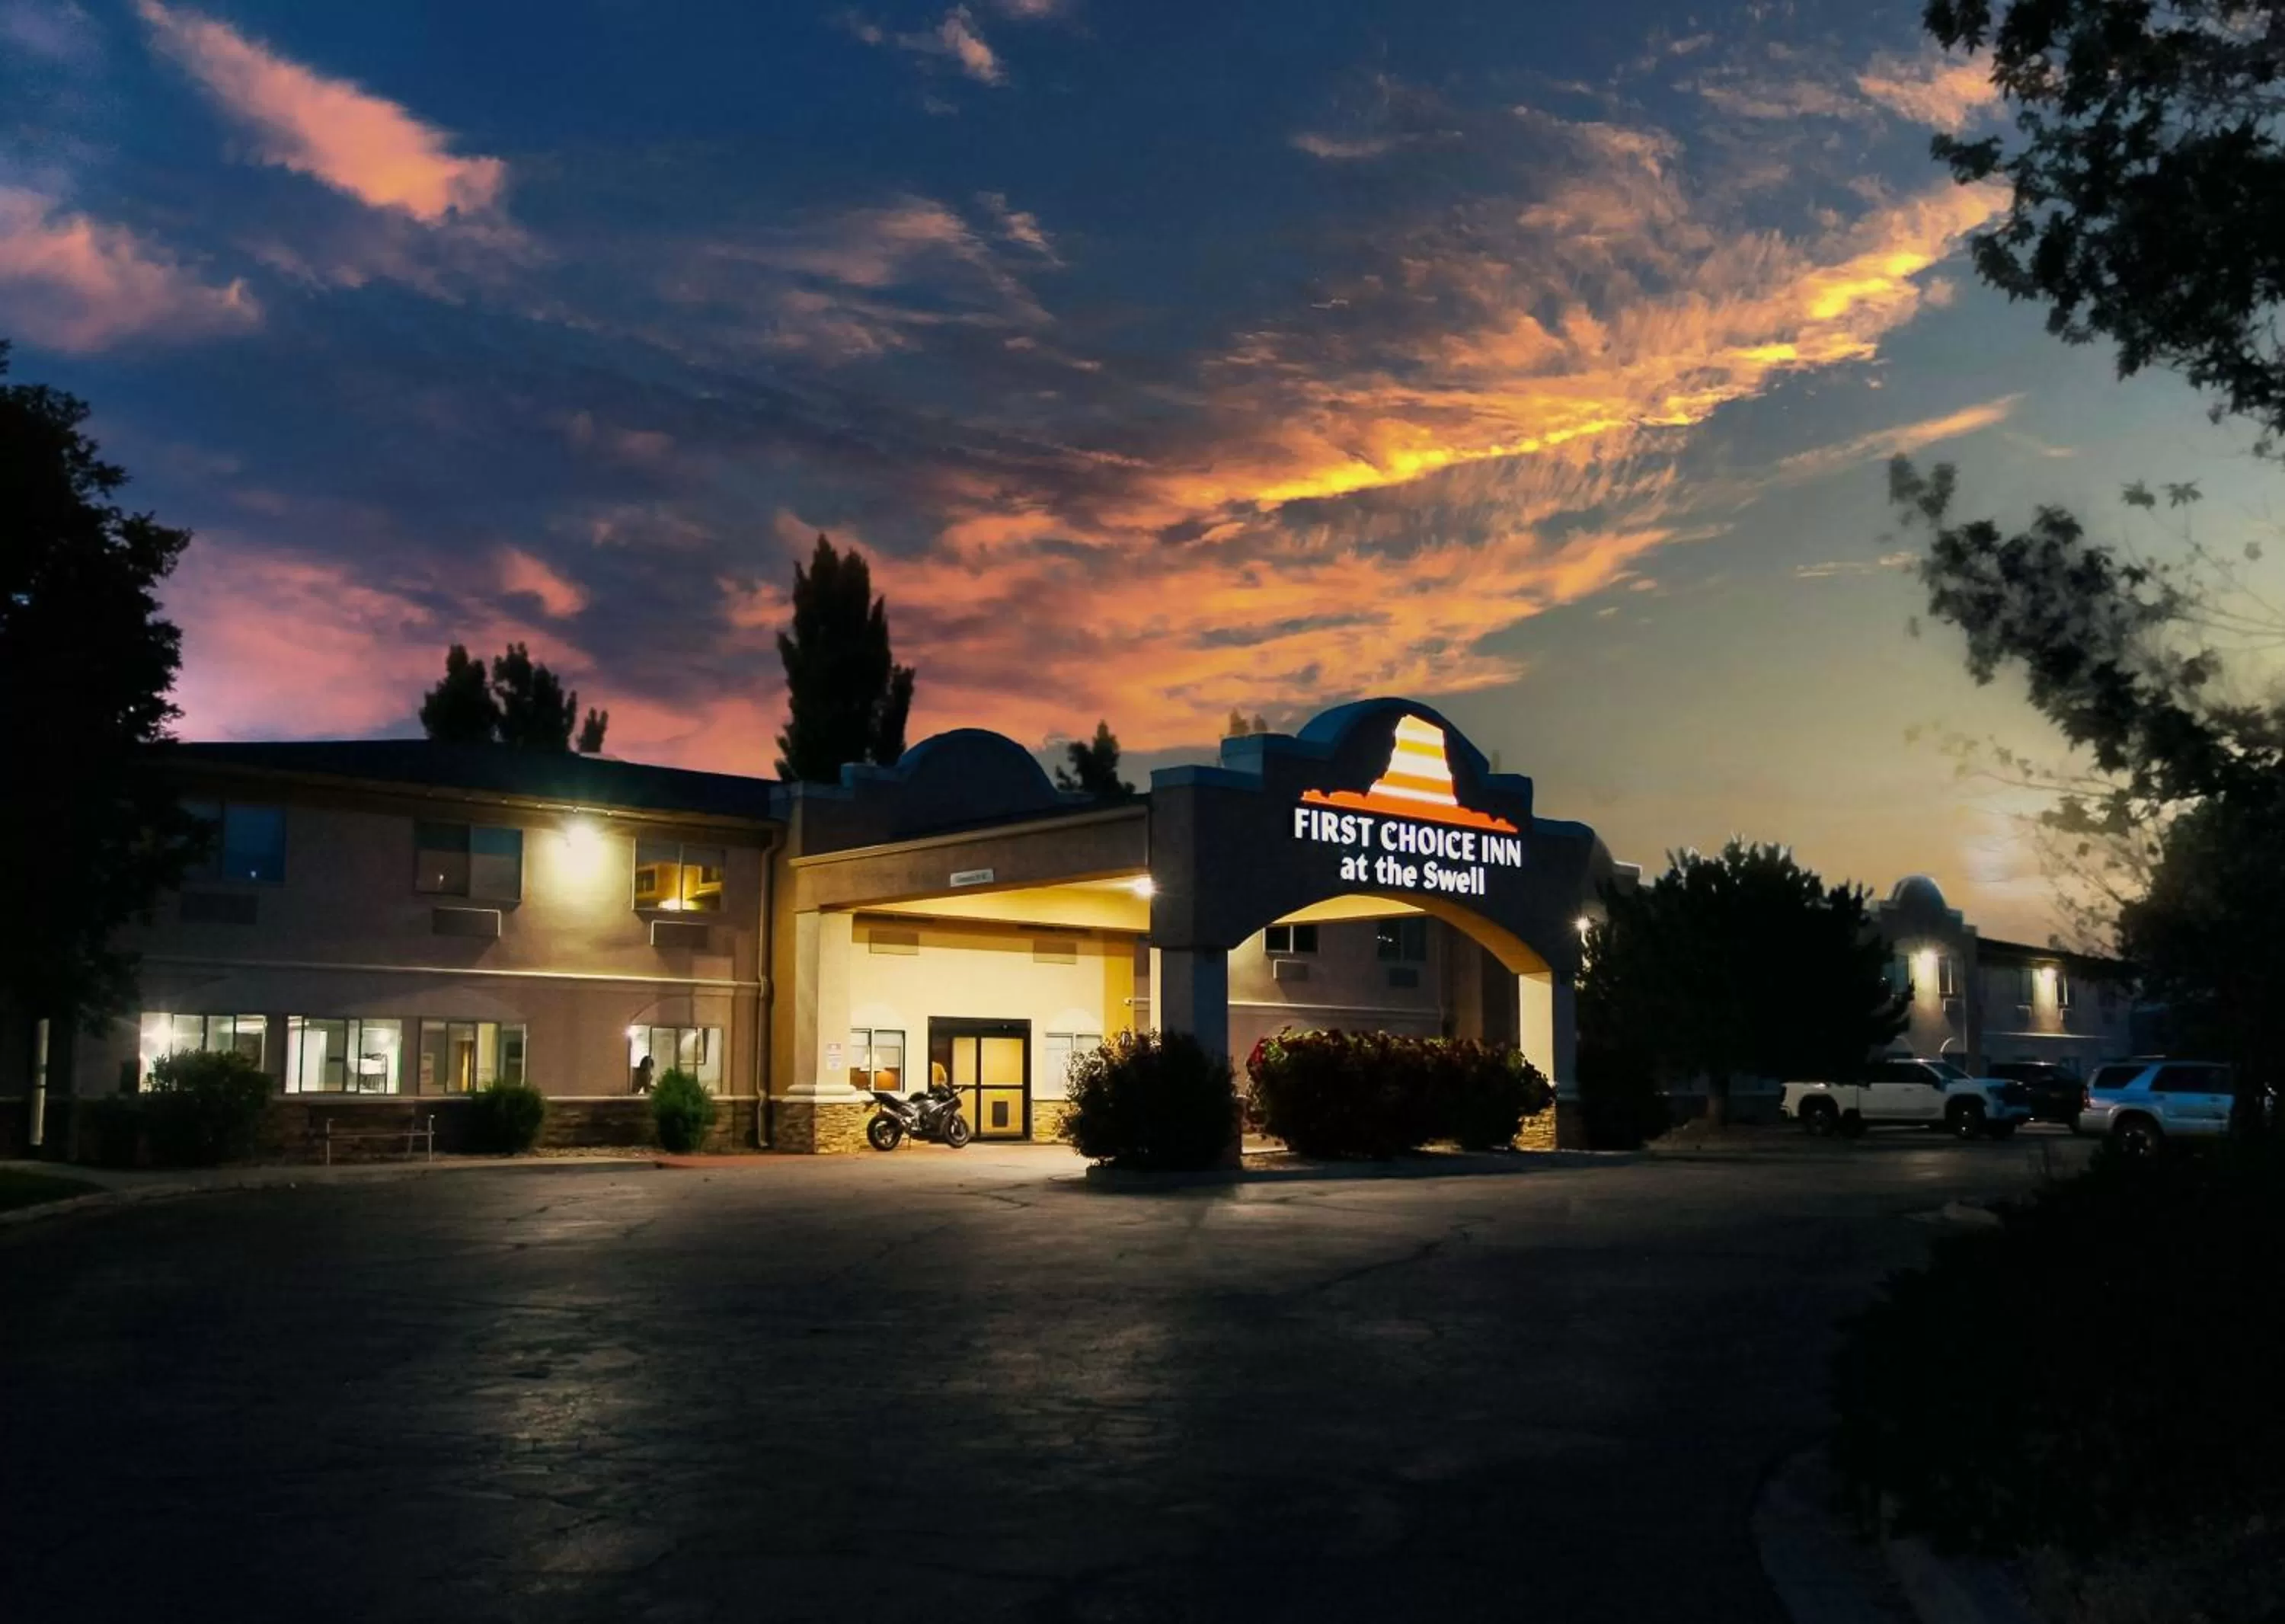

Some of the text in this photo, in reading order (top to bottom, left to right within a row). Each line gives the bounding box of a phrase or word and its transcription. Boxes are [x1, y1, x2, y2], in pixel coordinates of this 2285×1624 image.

[1295, 807, 1521, 868] FIRST CHOICE INN
[1340, 853, 1485, 895] at the Swell
